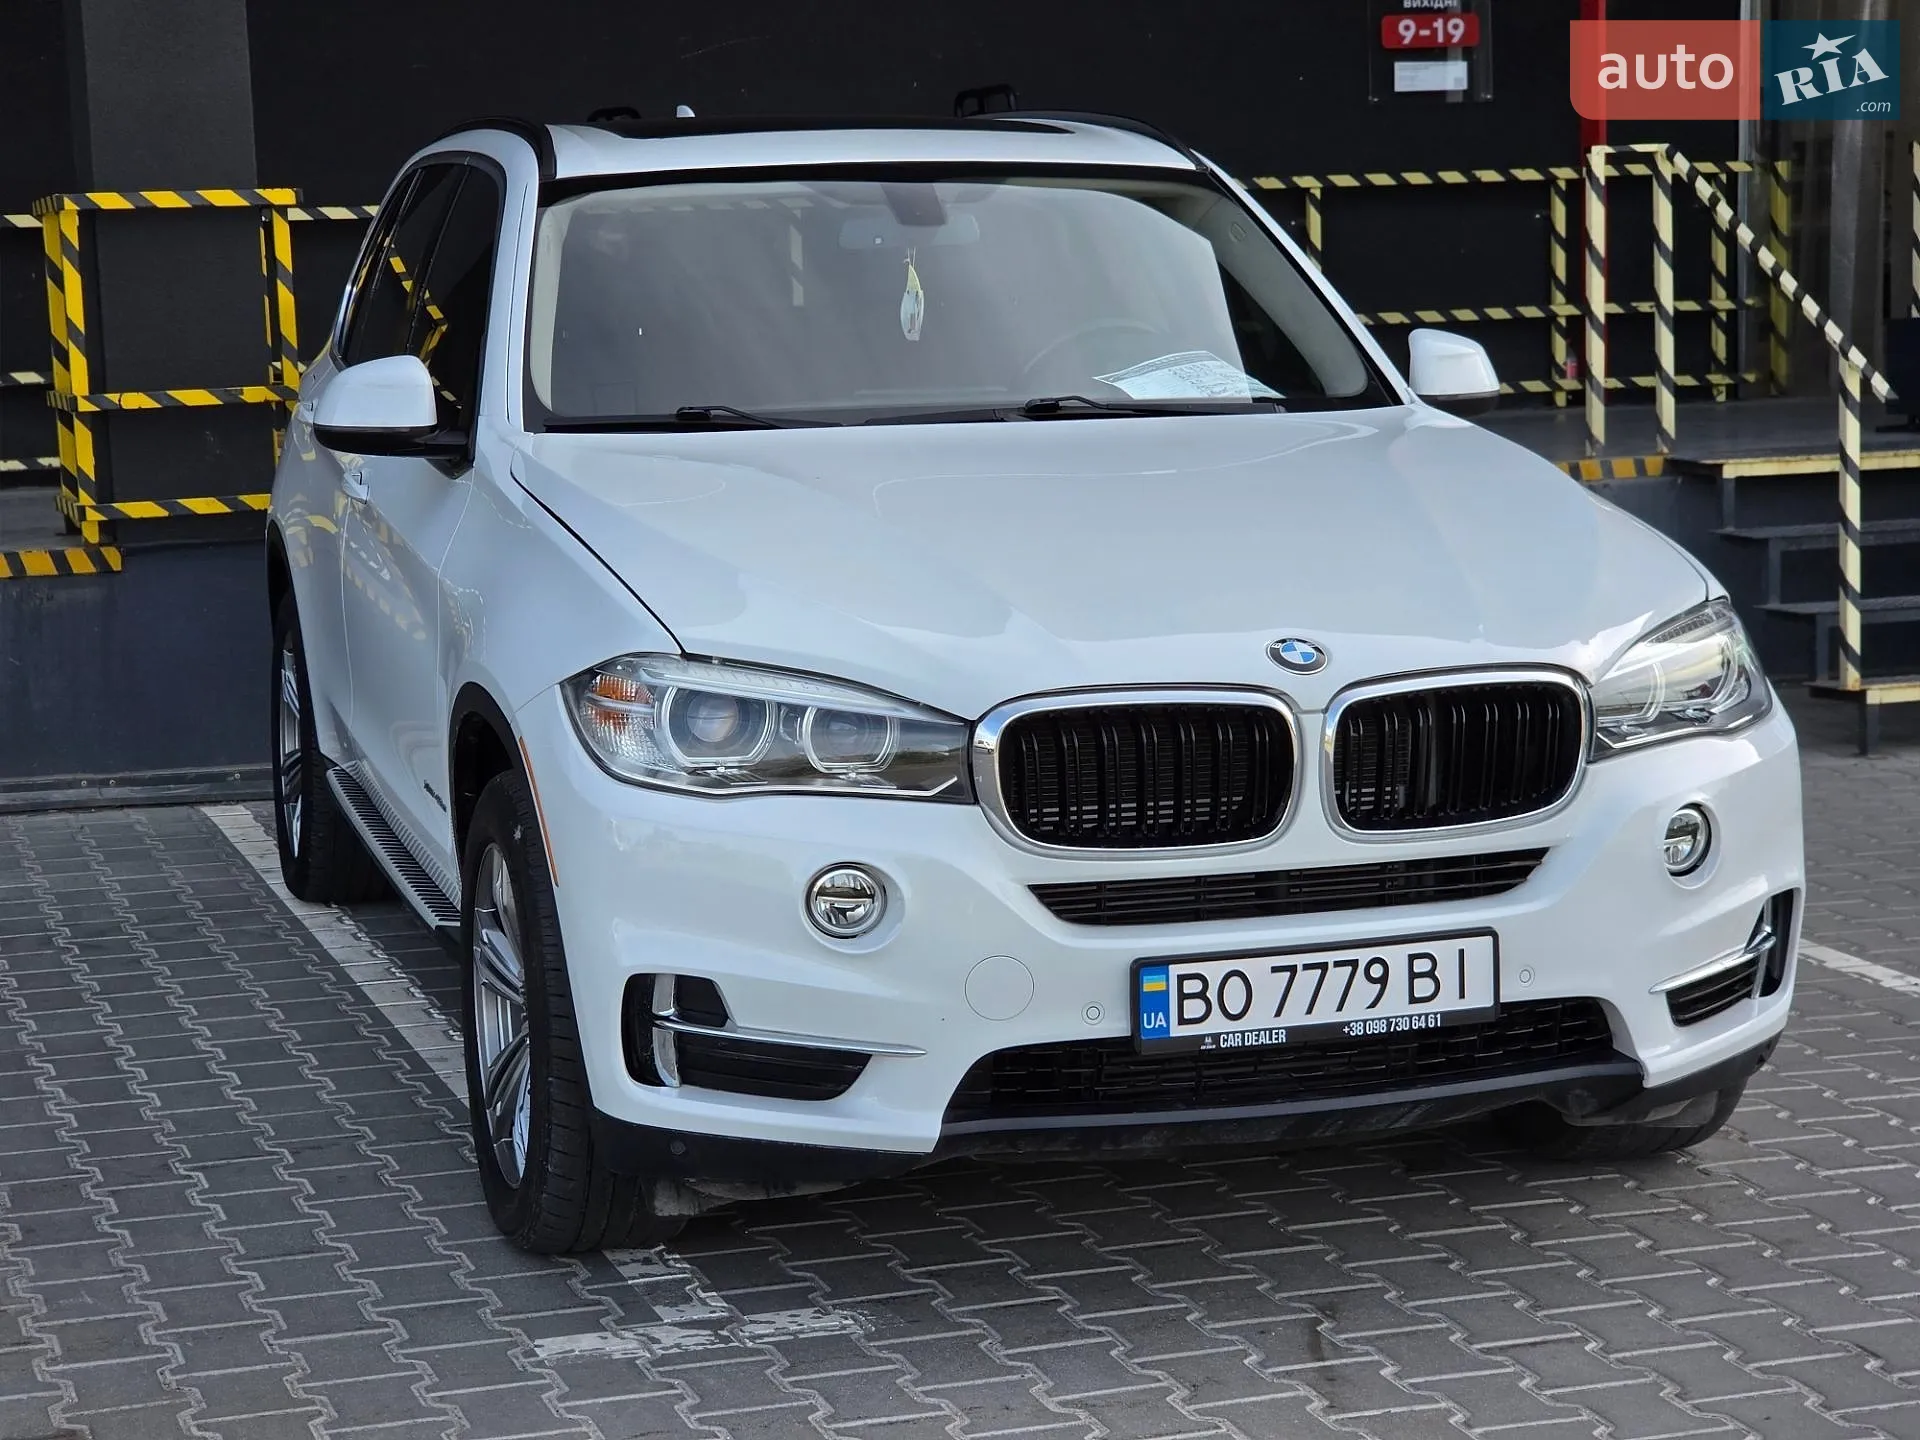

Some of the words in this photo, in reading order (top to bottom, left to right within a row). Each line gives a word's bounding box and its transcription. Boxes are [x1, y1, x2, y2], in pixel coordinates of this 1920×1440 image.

[1398, 17, 1465, 45] 9-19
[1176, 969, 1253, 1026] BO
[1270, 956, 1390, 1018] 7779
[1143, 1011, 1168, 1029] UA
[1342, 1021, 1364, 1037] +38
[1365, 1019, 1387, 1034] 098
[1389, 1017, 1410, 1032] 730
[1411, 1015, 1426, 1030] 64
[1427, 1013, 1441, 1028] 61
[1219, 1033, 1242, 1048] CAR
[1244, 1029, 1287, 1046] DEALER
